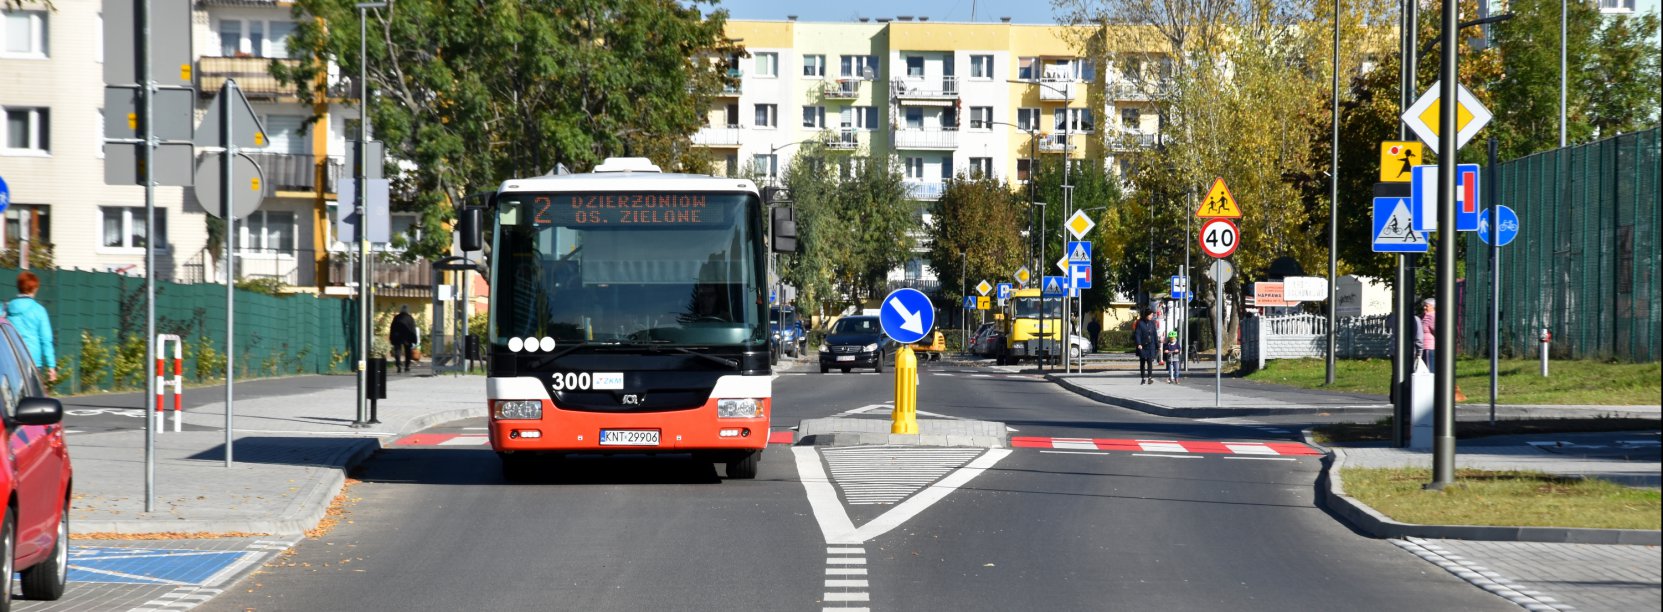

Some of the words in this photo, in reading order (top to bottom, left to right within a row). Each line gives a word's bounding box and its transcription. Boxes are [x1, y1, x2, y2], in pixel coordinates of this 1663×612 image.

[533, 196, 551, 223] 2
[575, 210, 608, 224] OS.
[620, 210, 702, 223] ZIELONE
[1205, 228, 1234, 248] 40
[1000, 285, 1009, 298] P
[552, 372, 591, 390] 300
[605, 431, 625, 442] KNT
[628, 431, 658, 443] 29906
